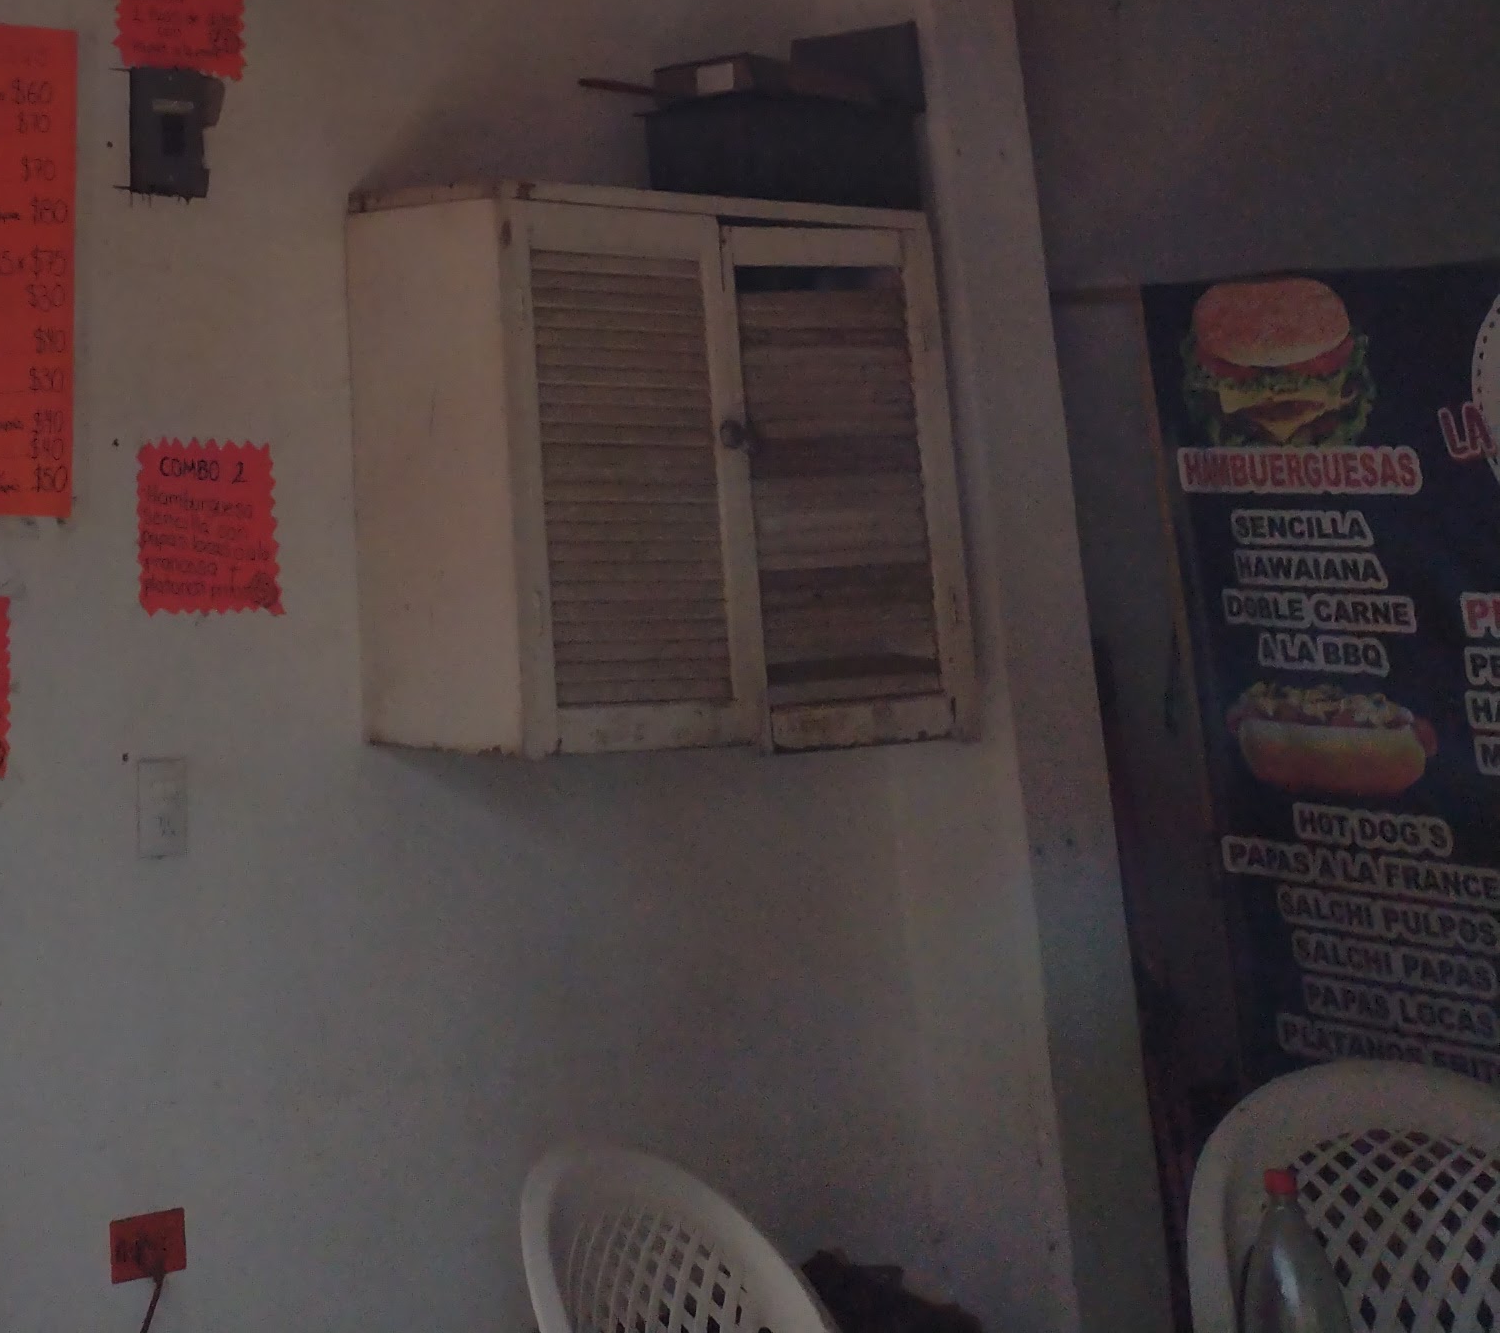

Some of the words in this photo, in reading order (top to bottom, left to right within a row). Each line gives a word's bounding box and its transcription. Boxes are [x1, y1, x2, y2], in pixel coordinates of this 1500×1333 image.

[159, 455, 220, 482] COMBO
[232, 461, 248, 484] 2
[1233, 512, 1370, 543] SENCILLA
[1238, 555, 1382, 584] HAWAIANA
[1226, 593, 1306, 622] DOBLE
[1313, 598, 1412, 628] CARNE
[1281, 638, 1315, 664] LA
[1321, 640, 1383, 669] BBQ
[1298, 810, 1349, 839] HOT
